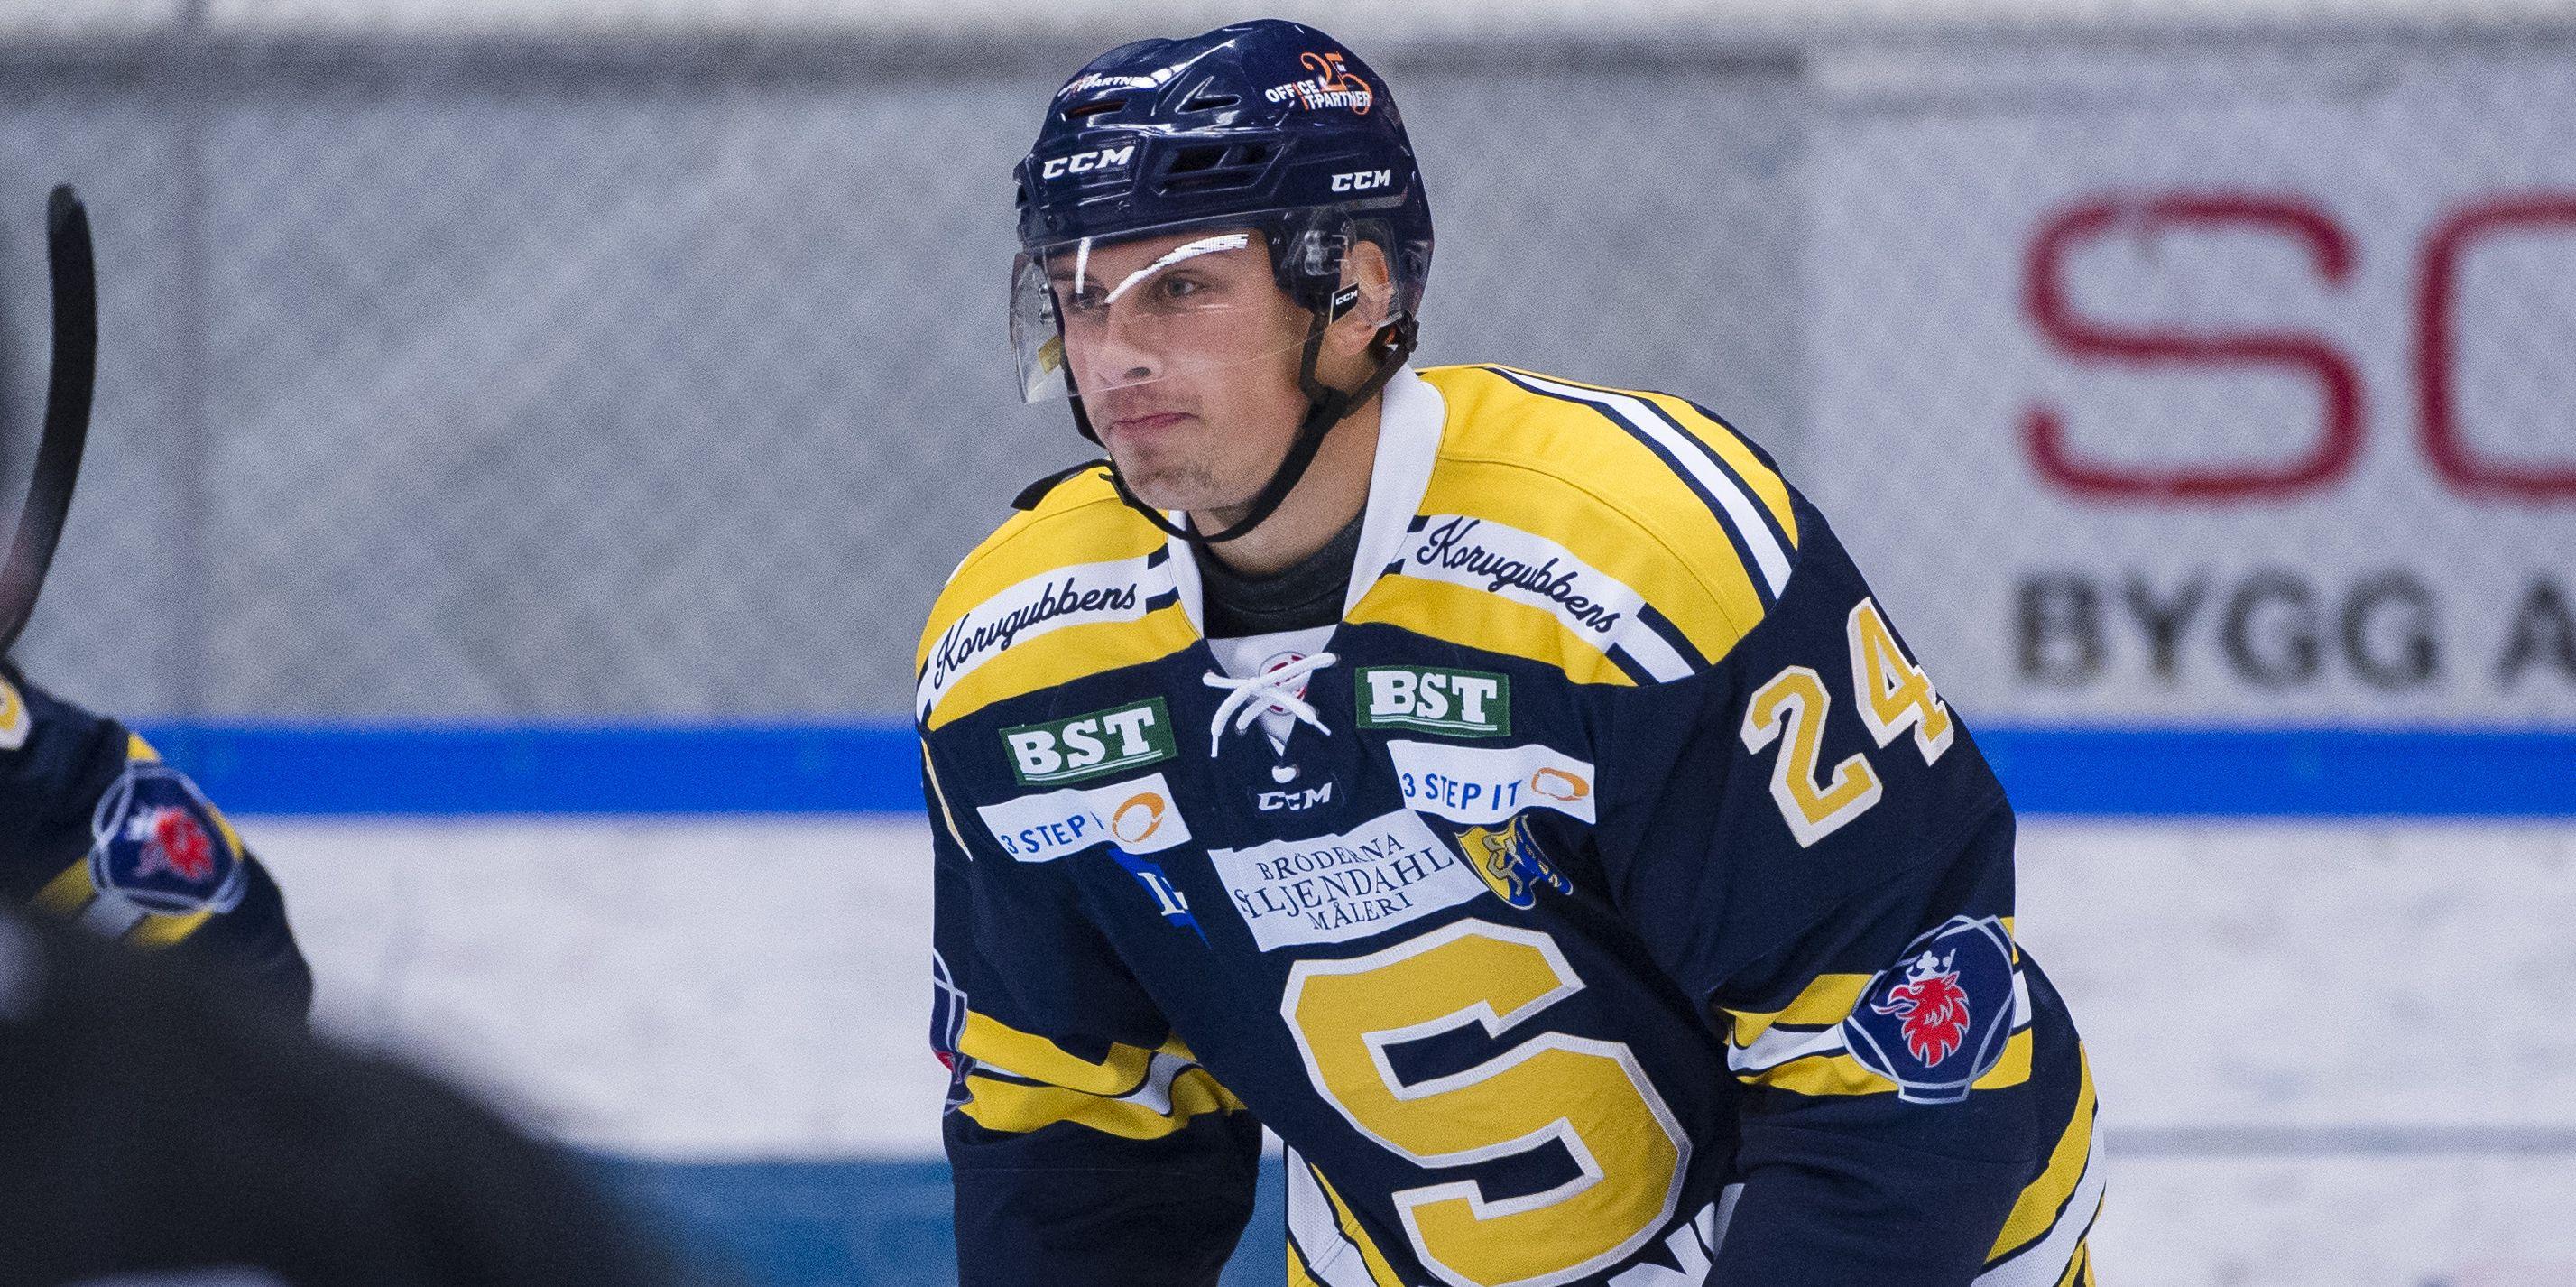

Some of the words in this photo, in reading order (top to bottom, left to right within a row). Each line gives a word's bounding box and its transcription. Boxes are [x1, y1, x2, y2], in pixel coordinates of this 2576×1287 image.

[1265, 79, 1319, 103] OFFICE
[1042, 145, 1135, 180] CCM
[1331, 169, 1391, 192] CCM
[1335, 289, 1358, 305] CCM
[1417, 515, 1621, 634] Korvgubbens
[933, 576, 1138, 690] Korvgubbens
[2010, 567, 2442, 691] BYGG
[1366, 670, 1498, 724] BST
[1006, 706, 1156, 775] BST
[1739, 596, 1955, 849] 24
[1257, 782, 1333, 811] CCM
[1401, 773, 1417, 798] 3
[1425, 773, 1482, 810] STEP
[1491, 778, 1523, 810] IT
[1000, 834, 1019, 855] 3
[1019, 814, 1086, 854] STEP
[1256, 831, 1405, 881] BRÖDERNA
[1306, 890, 1414, 931] MÅLERI
[1279, 916, 1694, 1287] S
